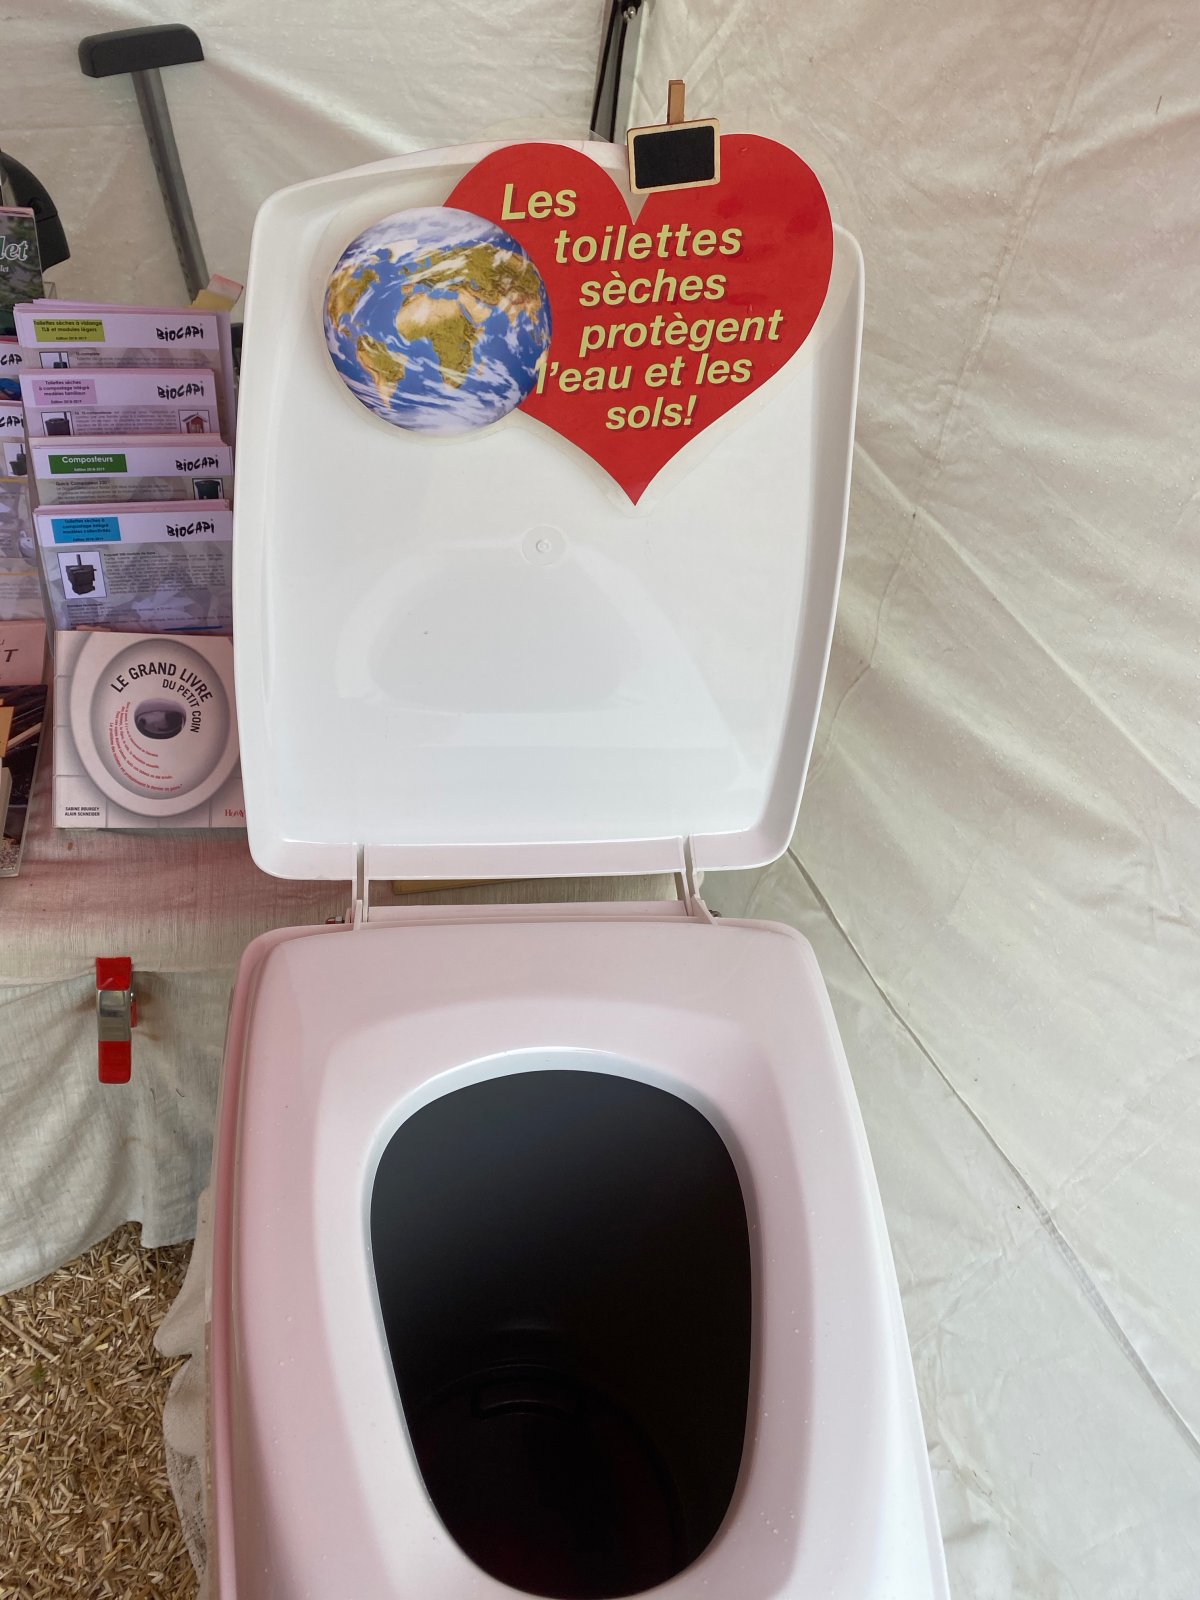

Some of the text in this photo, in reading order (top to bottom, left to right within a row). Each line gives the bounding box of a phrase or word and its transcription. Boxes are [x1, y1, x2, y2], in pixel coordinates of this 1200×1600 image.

[501, 183, 578, 221] Les
[554, 224, 743, 264] toilettes
[578, 269, 727, 307] sèches
[578, 309, 784, 358] protègent
[536, 353, 753, 394] l'eau et les
[605, 395, 697, 430] sols!
[61, 456, 114, 465] Composteurs
[110, 661, 213, 703] LE GRAND LIVRE
[162, 678, 202, 734] DU PETIT COIN
